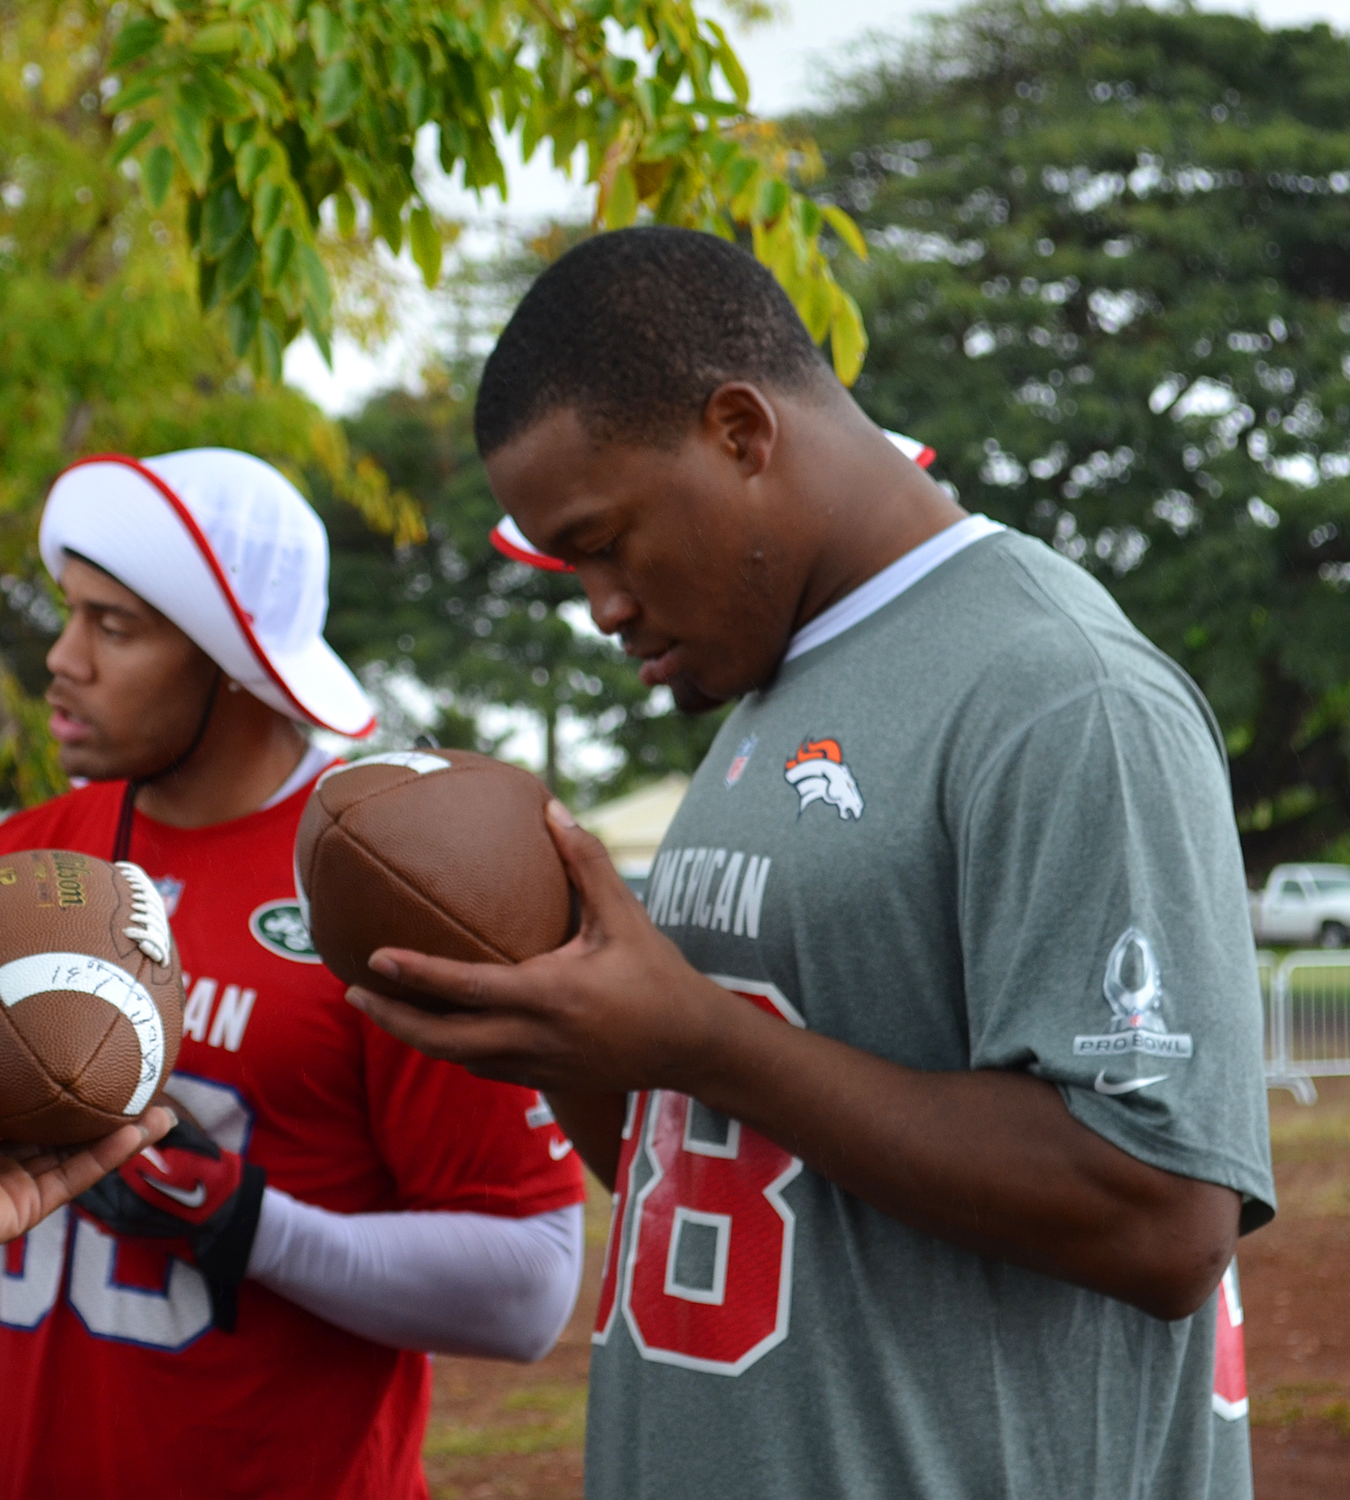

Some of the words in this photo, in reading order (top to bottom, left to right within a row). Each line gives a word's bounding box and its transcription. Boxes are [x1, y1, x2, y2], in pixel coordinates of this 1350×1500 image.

[181, 971, 258, 1053] AN
[1079, 1039, 1127, 1052] PRO
[1132, 1033, 1188, 1054] BOWL
